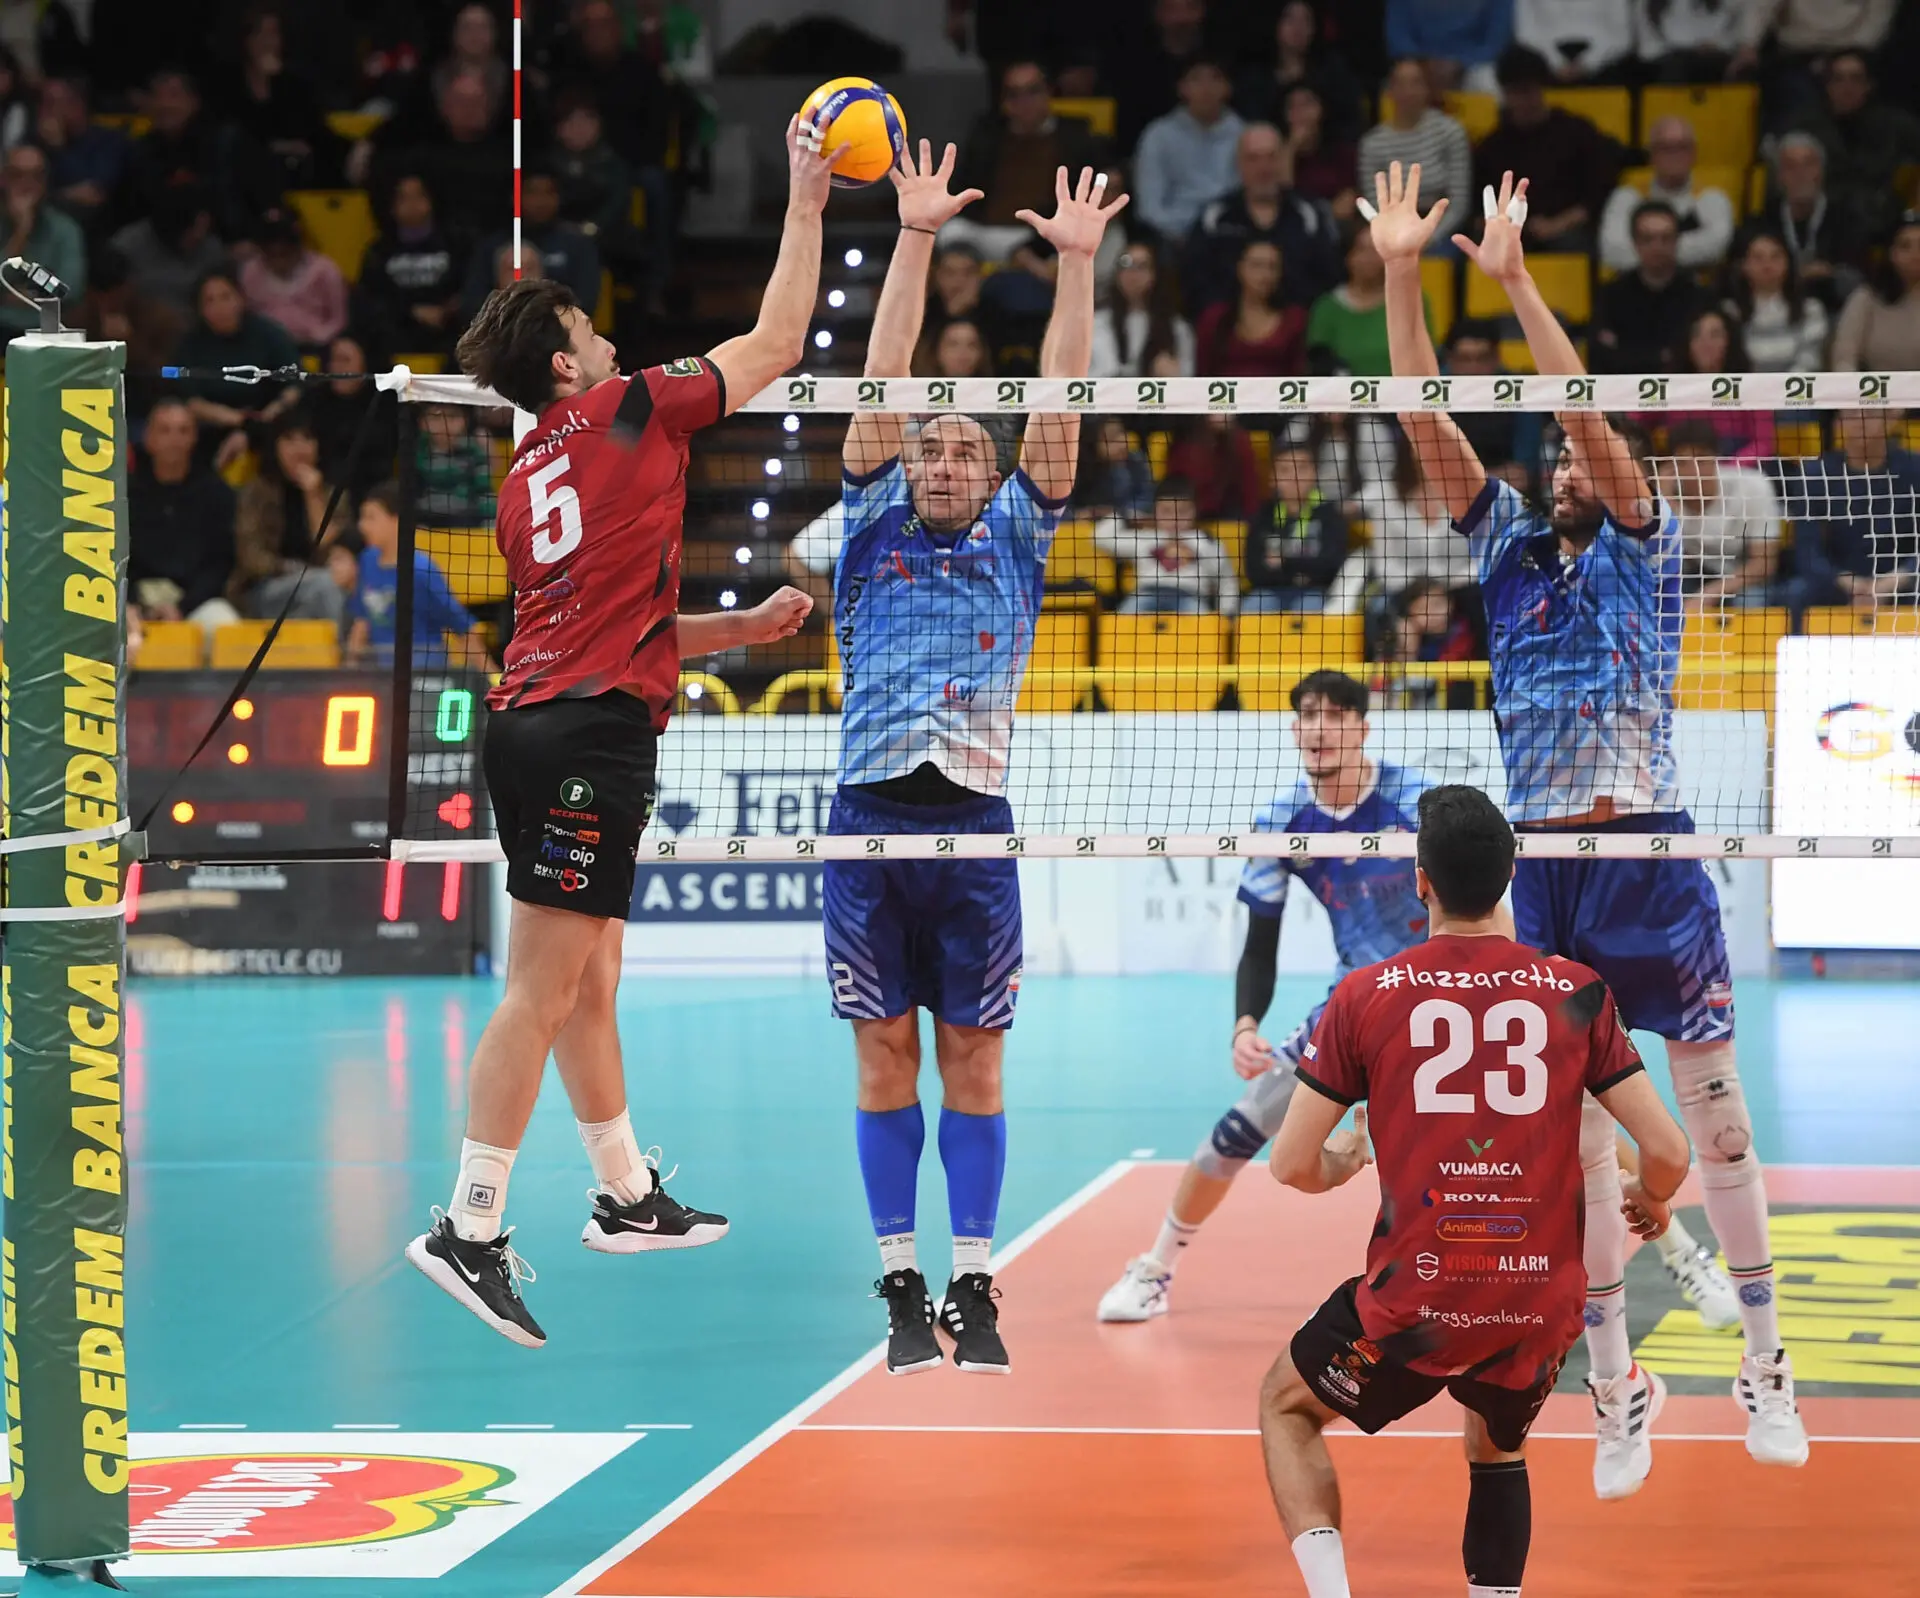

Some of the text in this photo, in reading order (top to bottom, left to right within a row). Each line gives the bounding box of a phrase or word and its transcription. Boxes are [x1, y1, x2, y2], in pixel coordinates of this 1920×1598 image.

[527, 453, 583, 564] 5
[61, 388, 119, 908] CREDEM BANCA
[436, 689, 472, 742] 0
[322, 696, 375, 766] 0
[569, 784, 584, 802] B
[1375, 963, 1575, 993] #lazzaretto
[1409, 998, 1549, 1116] 23
[1439, 1162, 1523, 1176] VUMBACA
[1443, 1193, 1501, 1203] ROVA
[67, 963, 129, 1495] CREDEM BANCA
[1443, 1221, 1521, 1234] AnimalStore
[1444, 1255, 1549, 1272] VISIONALARM
[1444, 1275, 1550, 1284] security system
[1417, 1304, 1544, 1328] #reggiocalabria
